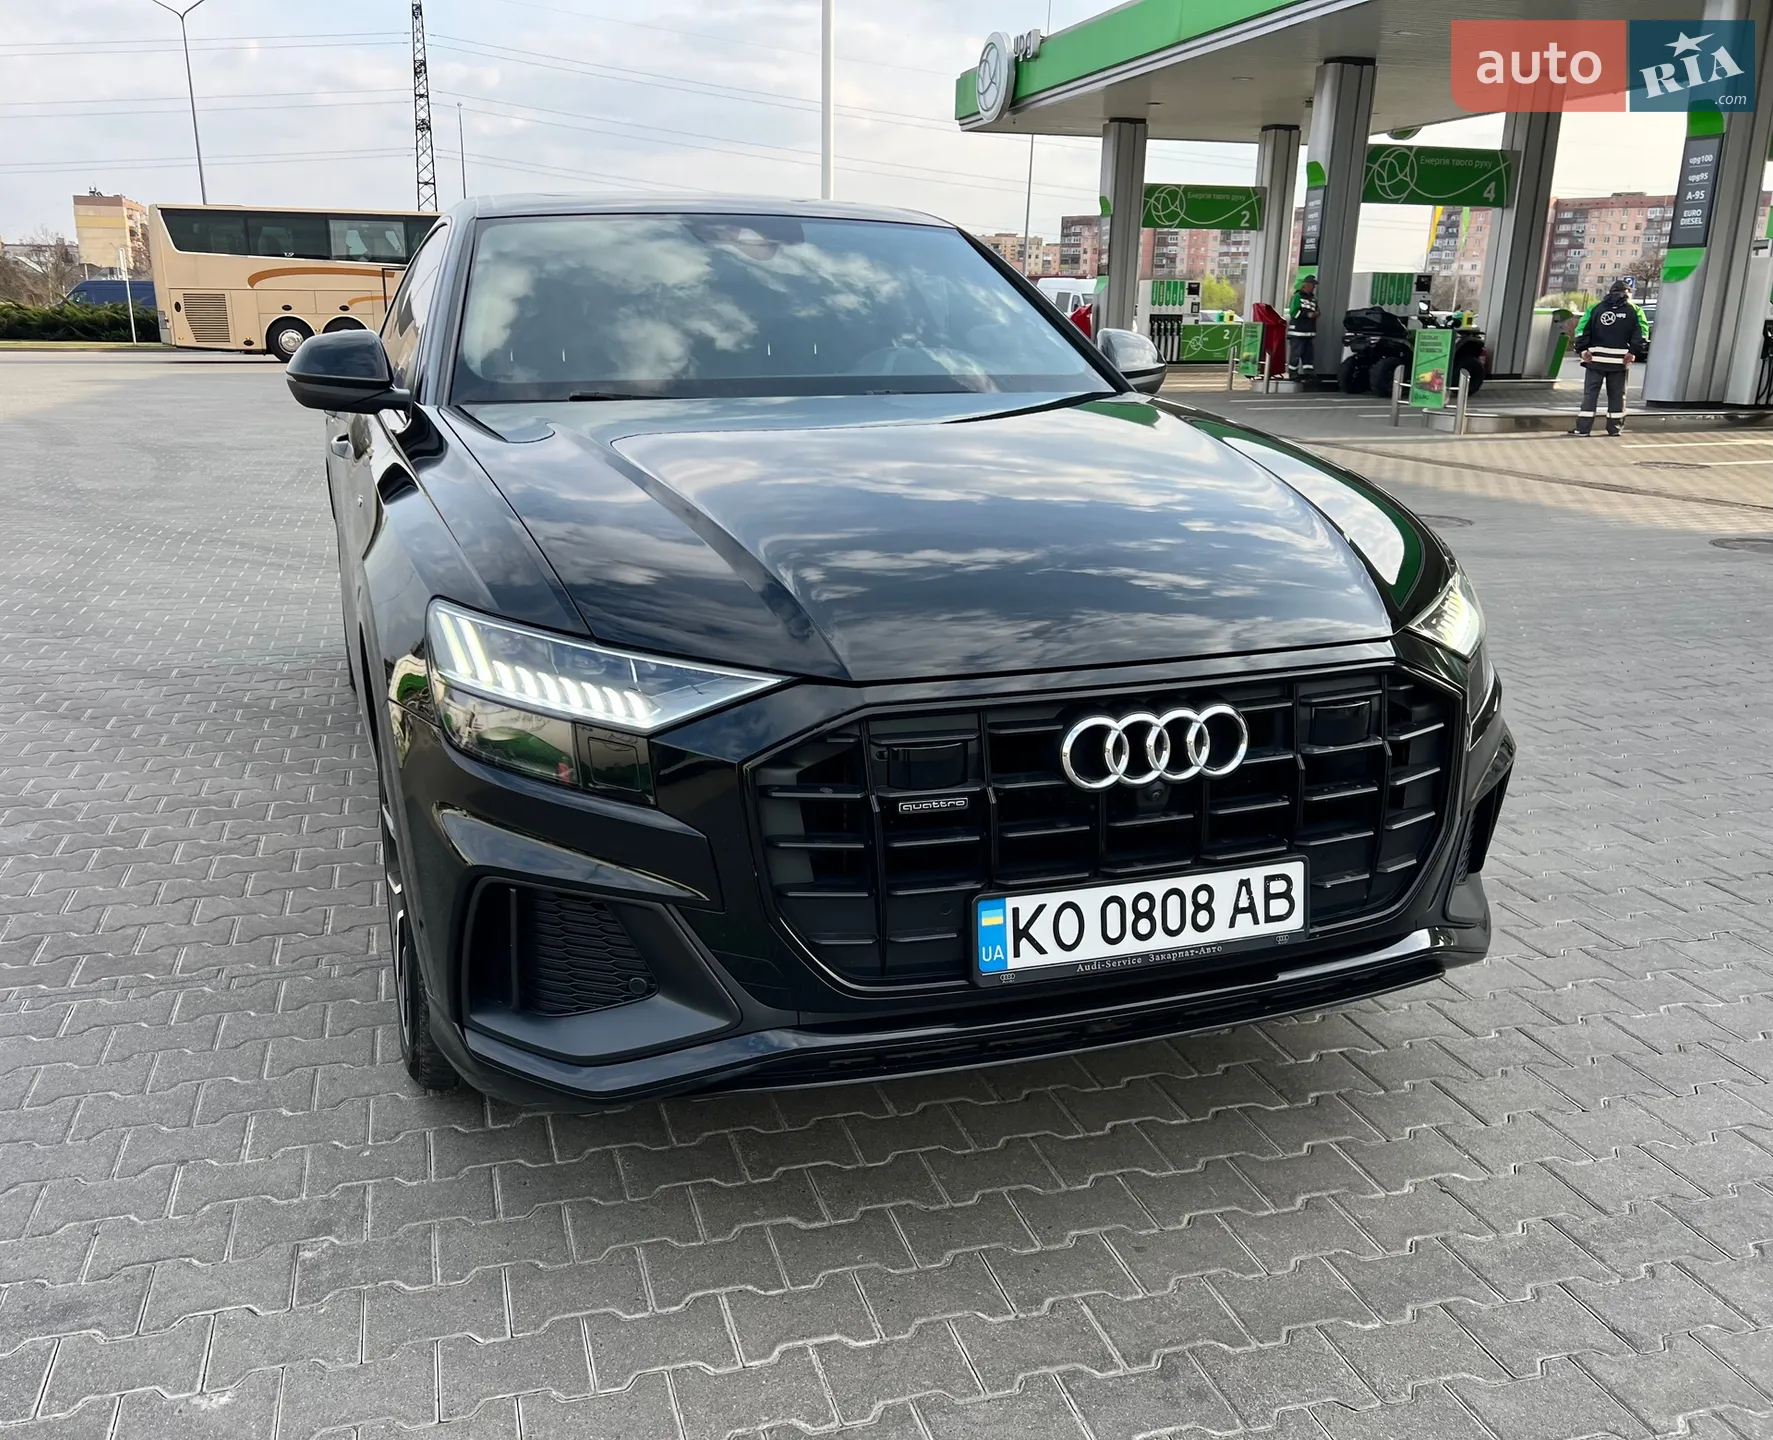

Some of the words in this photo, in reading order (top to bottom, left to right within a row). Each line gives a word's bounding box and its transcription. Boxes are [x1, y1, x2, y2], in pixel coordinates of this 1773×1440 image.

[1013, 29, 1040, 62] upg
[1420, 155, 1450, 166] Енергія
[1452, 157, 1473, 167] твого
[1474, 160, 1492, 169] руху
[1689, 154, 1713, 165] upg100
[1688, 172, 1708, 182] upg95
[1483, 181, 1496, 202] 4
[1686, 190, 1705, 200] A-95
[1240, 210, 1250, 227] 2
[1683, 209, 1702, 217] EURO
[1680, 217, 1703, 225] DIESEL
[1223, 329, 1231, 339] 2
[902, 800, 965, 811] quattro
[1011, 900, 1085, 958] KO
[1100, 883, 1216, 945] 0808
[1228, 873, 1296, 929] AB
[982, 945, 1005, 963] UA
[1076, 956, 1142, 973] Audi-Service
[1148, 944, 1223, 962] Закарпат-Авто
